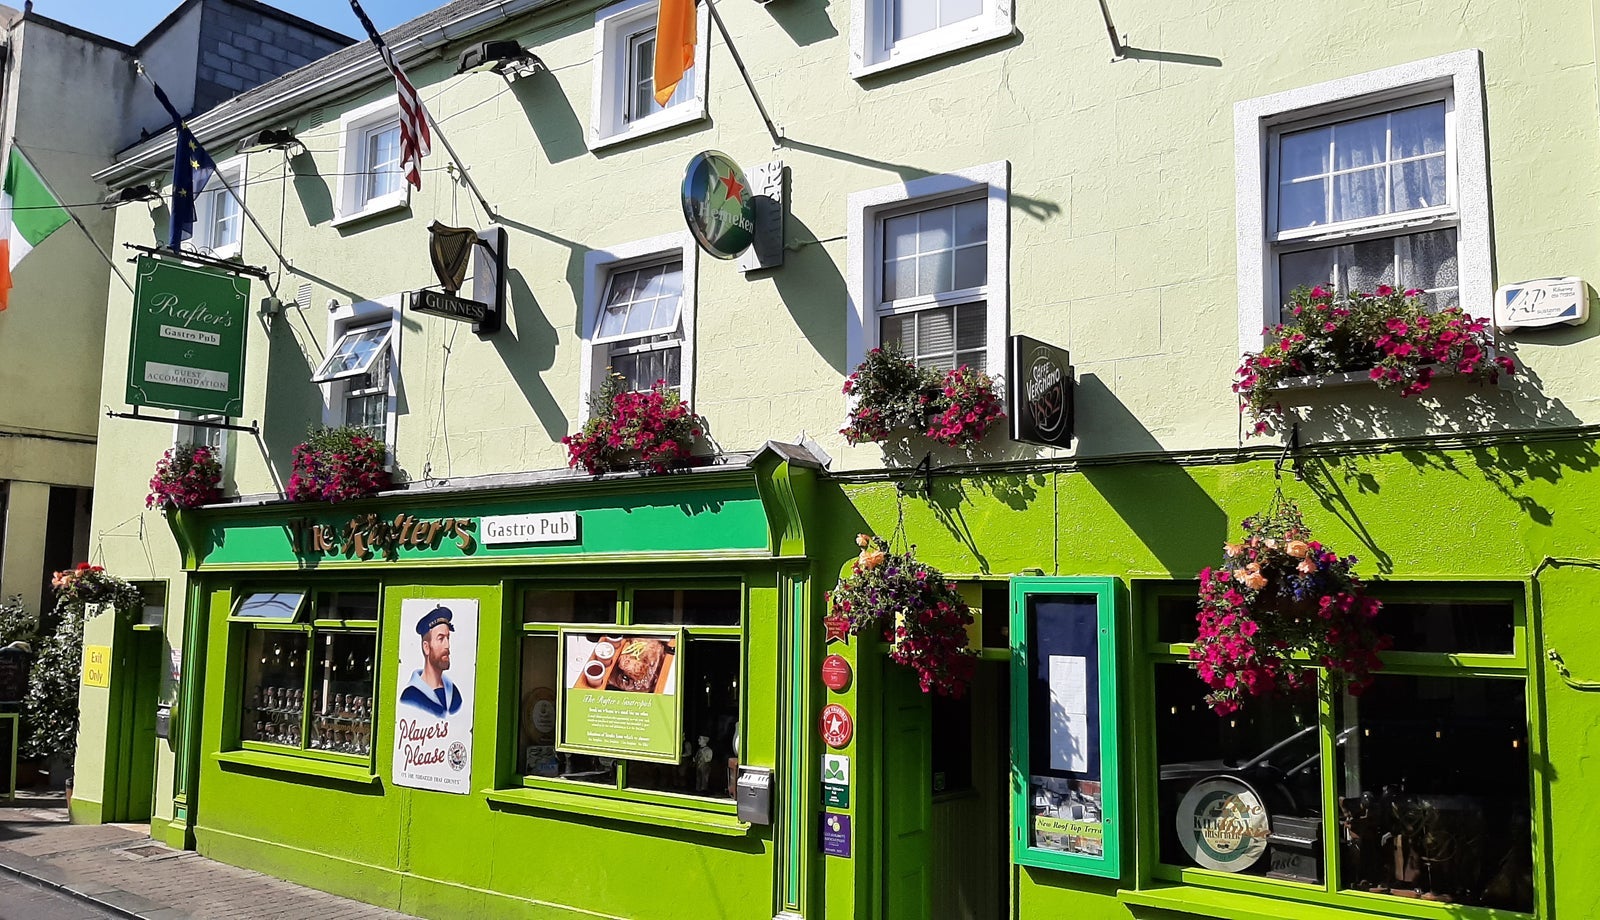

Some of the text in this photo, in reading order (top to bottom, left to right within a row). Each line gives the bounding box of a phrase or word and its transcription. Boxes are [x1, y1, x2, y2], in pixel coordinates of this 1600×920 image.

[698, 201, 754, 234] Heineken
[148, 292, 232, 327] Rafter's
[426, 293, 484, 318] GUINNESS
[165, 328, 217, 343] Gastro Pub
[148, 373, 226, 388] ACCOMMODATION
[174, 369, 201, 378] GUEST
[1026, 367, 1060, 401] VERGNANO
[1034, 386, 1060, 427] 1882
[487, 517, 569, 538] Gastro Pub
[91, 651, 103, 664] Exit
[89, 669, 103, 683] Only
[398, 718, 449, 750] Player's
[404, 744, 445, 771] Please
[1037, 819, 1052, 827] New
[1053, 821, 1069, 831] Roof
[1070, 823, 1082, 833] Top
